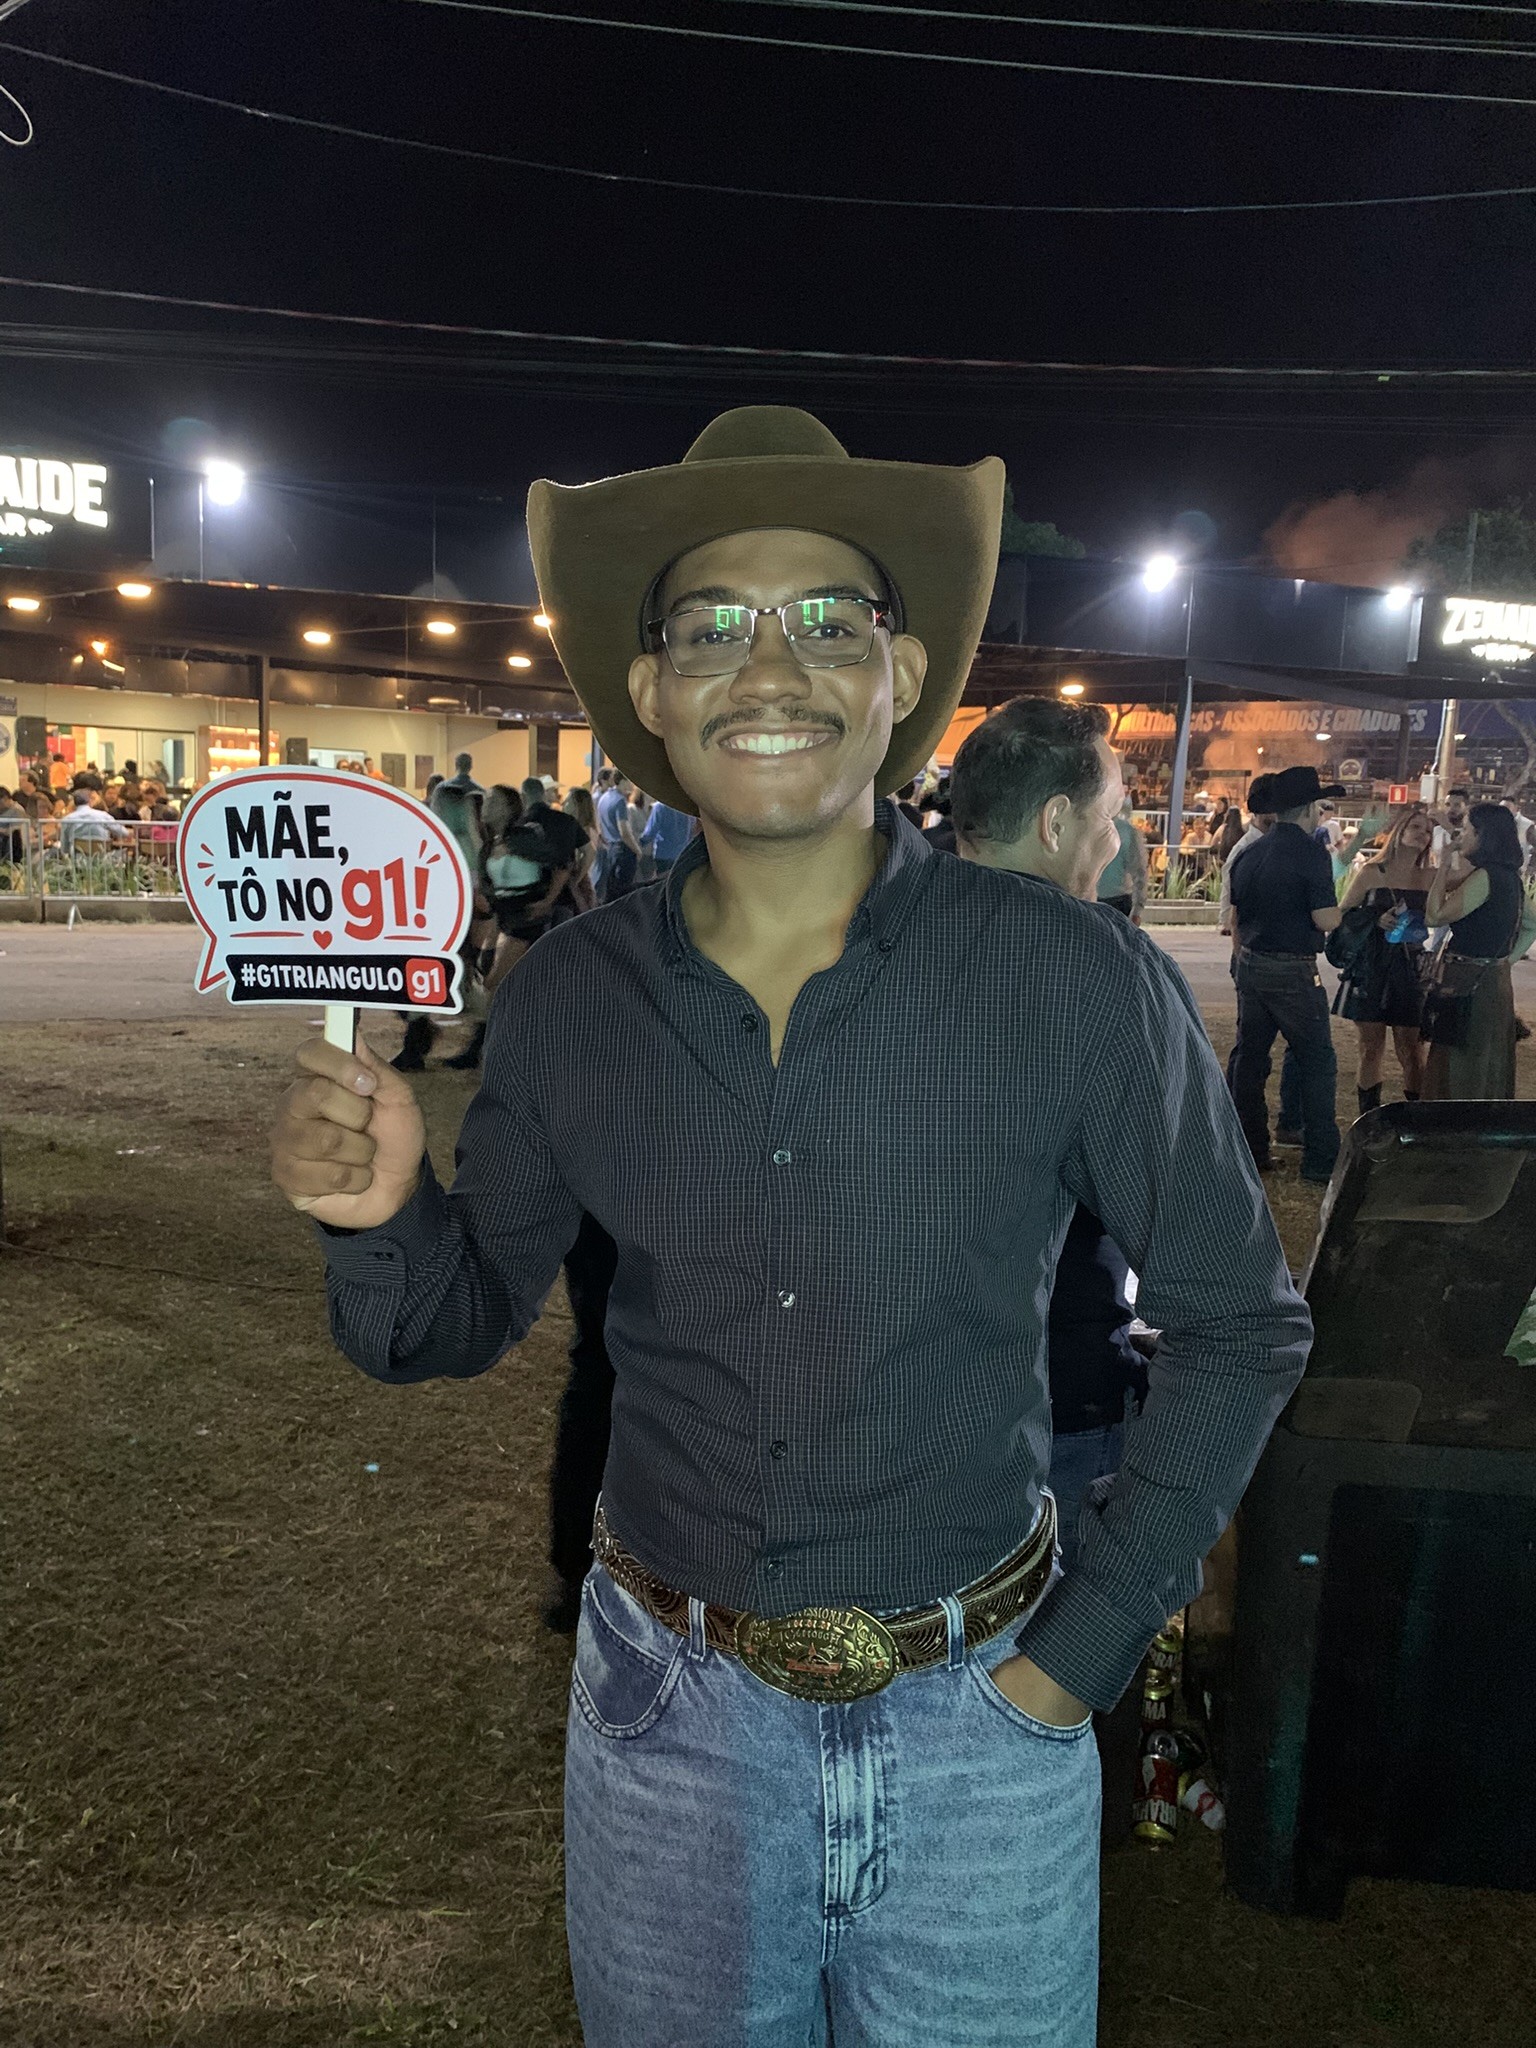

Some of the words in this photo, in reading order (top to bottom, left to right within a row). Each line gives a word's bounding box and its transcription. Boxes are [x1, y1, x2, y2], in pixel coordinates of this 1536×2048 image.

[1221, 709, 1320, 732] ASSOCIADOS
[1319, 709, 1333, 732] E
[224, 790, 349, 866] MÃE,
[217, 866, 267, 922] TÔ
[276, 877, 333, 922] NO
[341, 857, 430, 941] g1!
[240, 963, 404, 992] #G1TRIANGULO
[411, 967, 441, 998] g1
